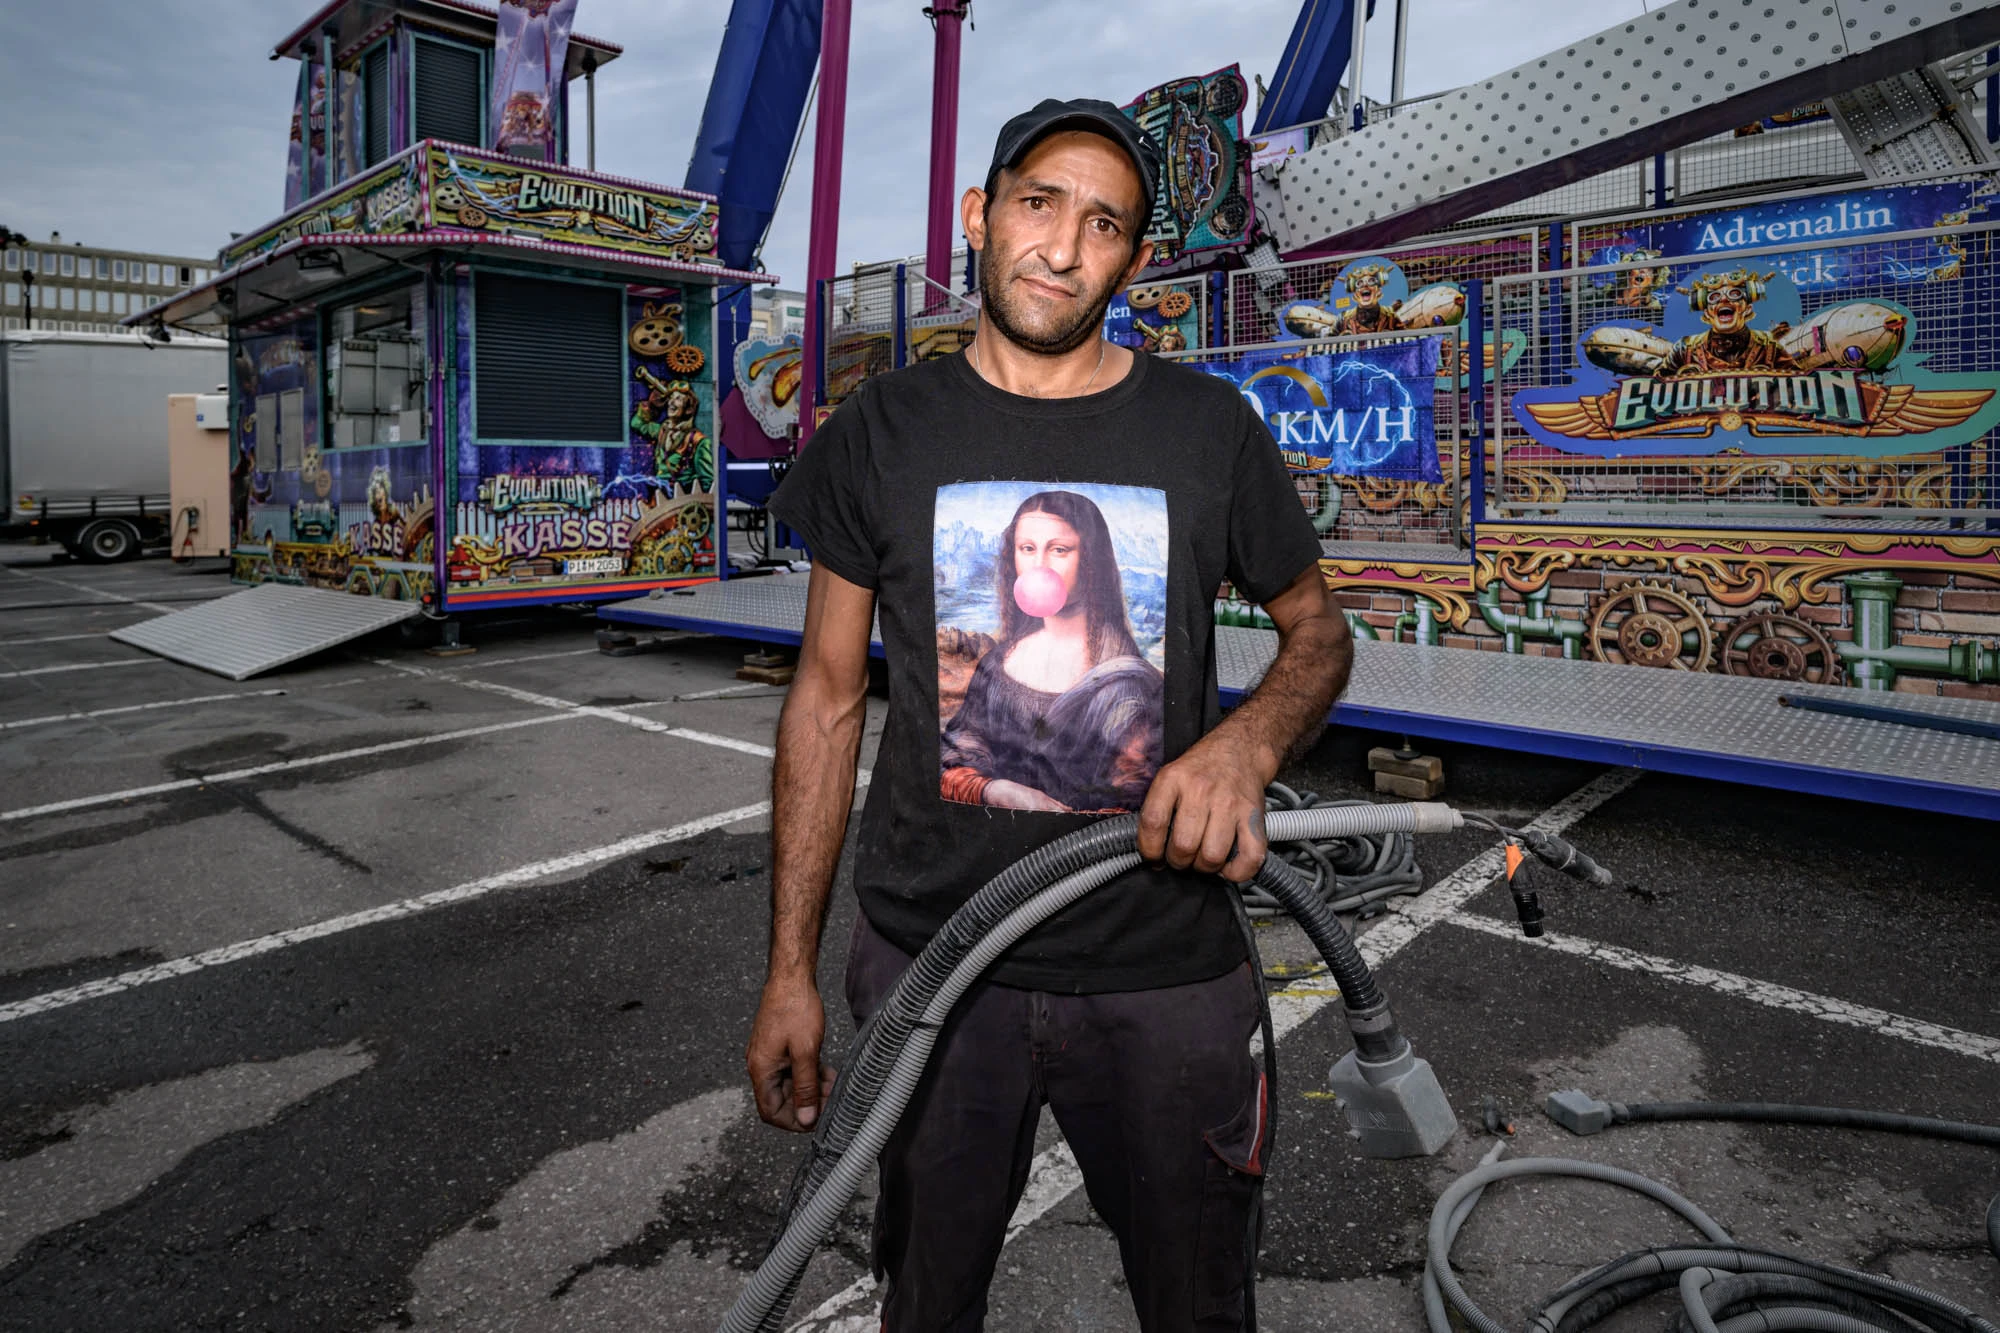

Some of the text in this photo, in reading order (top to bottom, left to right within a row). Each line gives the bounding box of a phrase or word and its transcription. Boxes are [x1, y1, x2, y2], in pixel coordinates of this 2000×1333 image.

[518, 174, 647, 230] EVOLUTION
[1696, 202, 1894, 250] Adrenalin
[1613, 370, 1866, 428] EVOLUTION
[1277, 405, 1415, 451] KM/H
[493, 473, 592, 512] EVOLUTION
[350, 520, 404, 557] KASSE
[502, 518, 633, 558] KASSE
[597, 559, 621, 571] 2053
